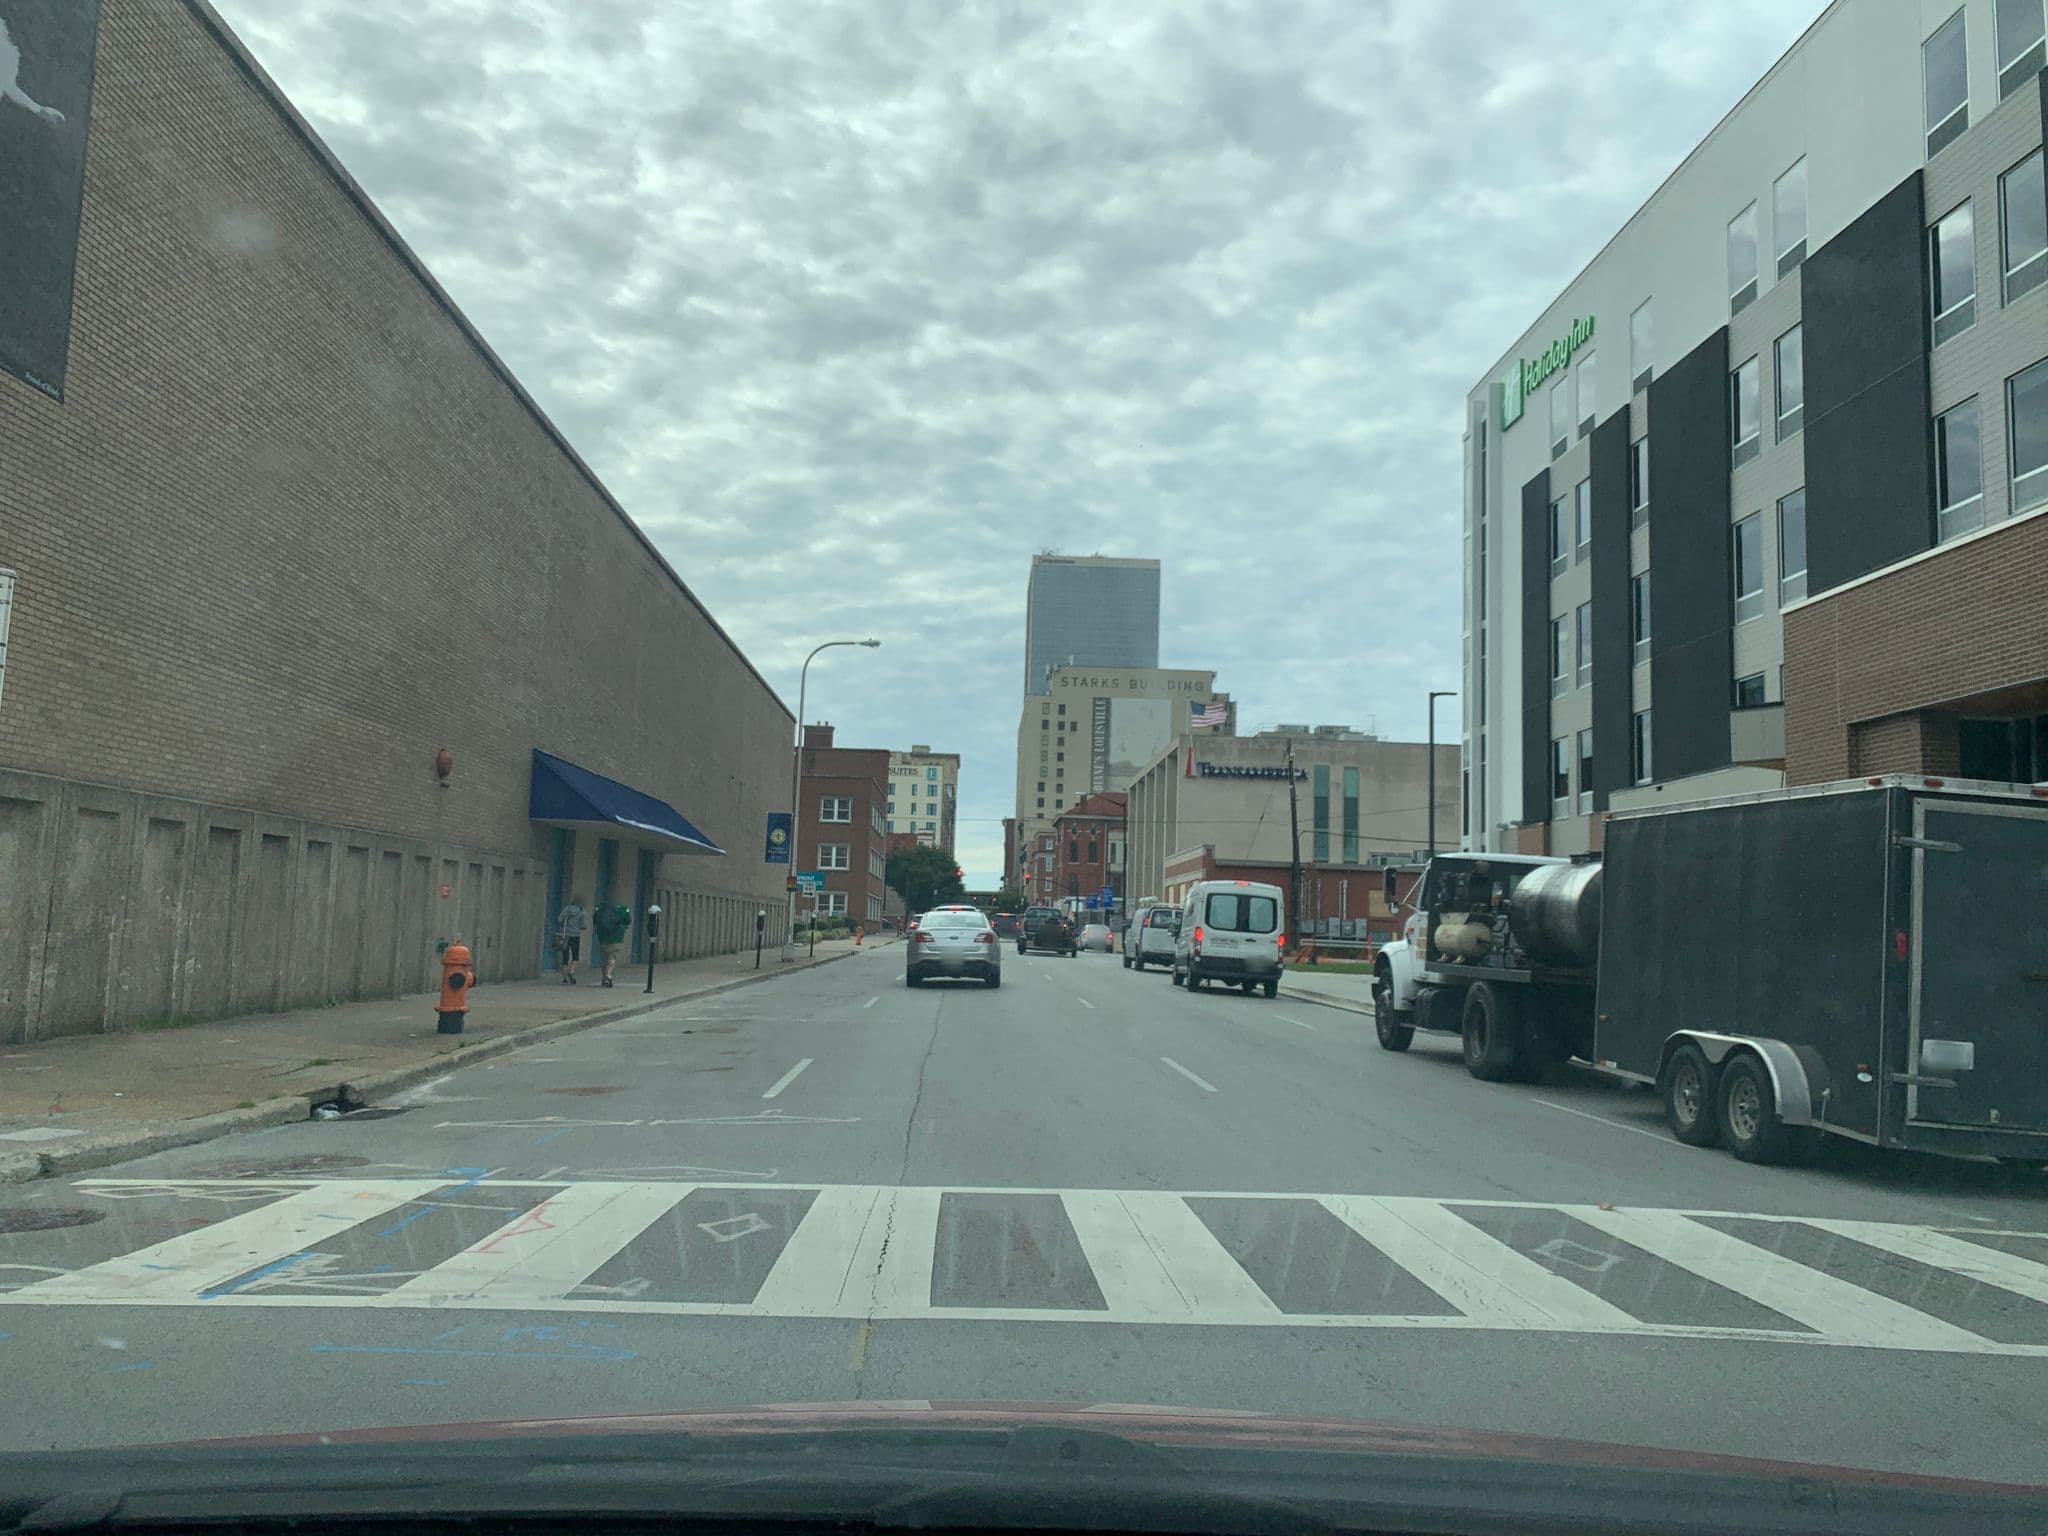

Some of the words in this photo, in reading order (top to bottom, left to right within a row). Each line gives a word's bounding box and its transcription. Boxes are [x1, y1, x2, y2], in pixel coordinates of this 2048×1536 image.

[1524, 337, 1571, 395] Holiday
[1570, 316, 1595, 352] Inn
[1060, 676, 1120, 689] STARKS
[1129, 679, 1204, 692] BUDING
[1094, 699, 1106, 752] LOUISVILLE
[888, 767, 919, 777] SUITES
[1197, 762, 1308, 781] TRANSAMERCA
